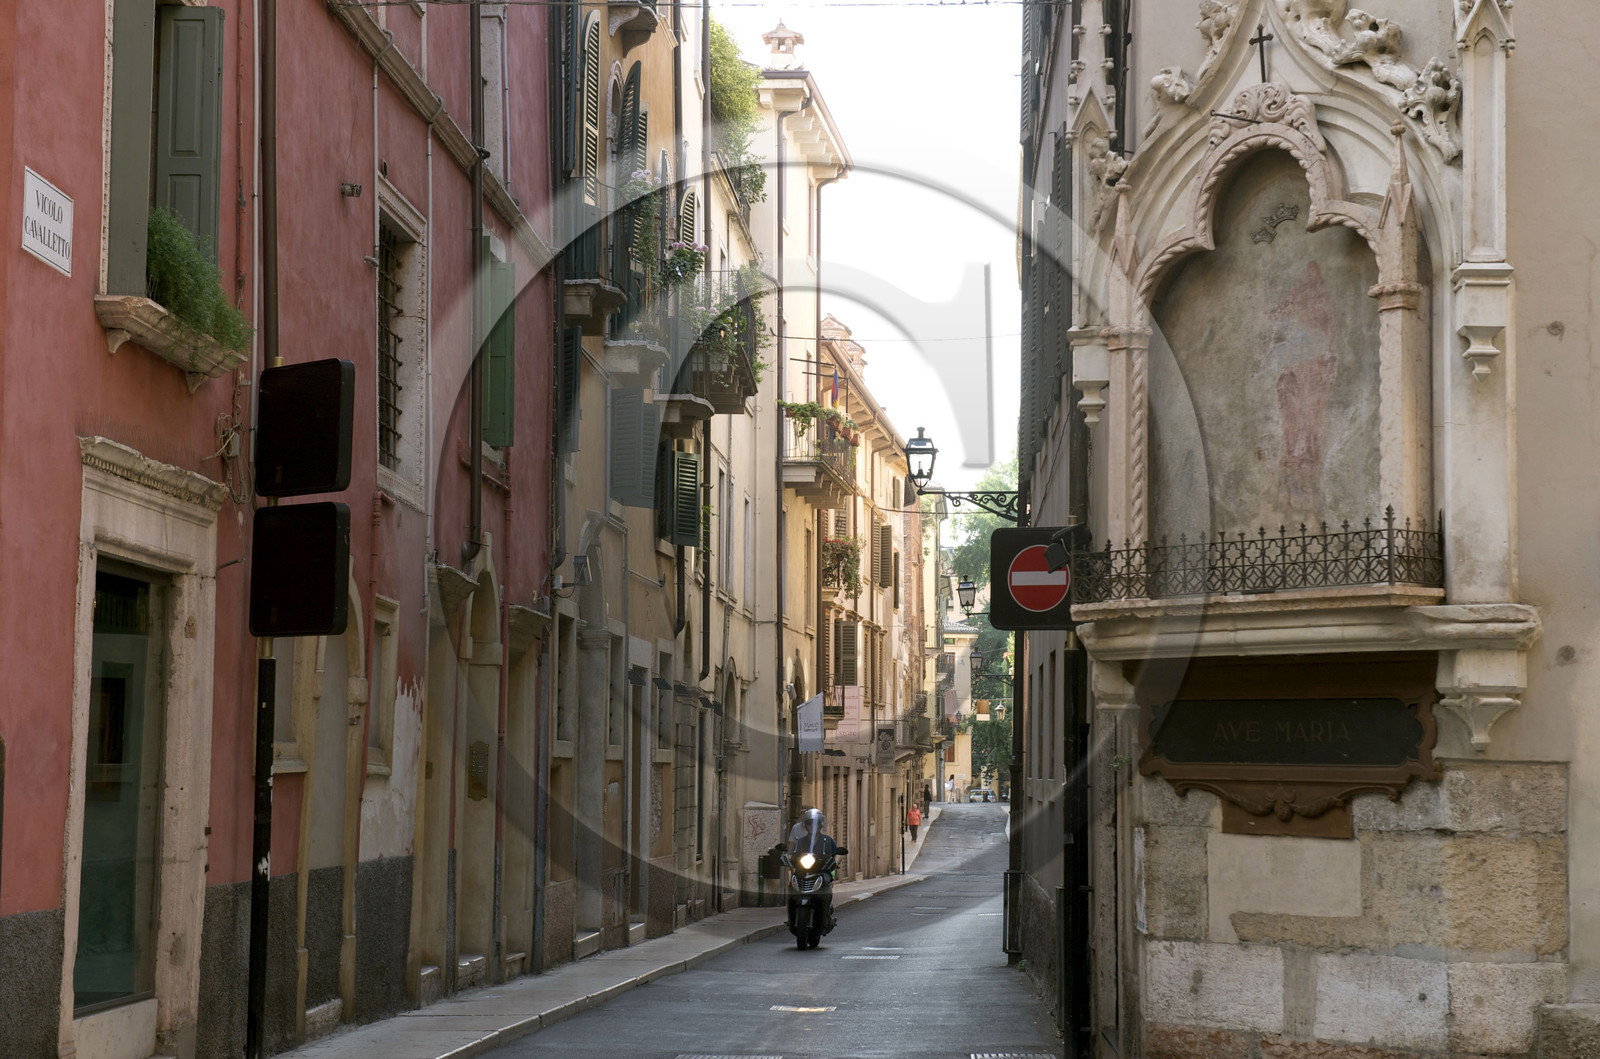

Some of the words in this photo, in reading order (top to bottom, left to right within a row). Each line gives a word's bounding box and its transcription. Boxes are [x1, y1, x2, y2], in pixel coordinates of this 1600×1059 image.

[36, 190, 63, 224] VICOLO
[24, 215, 71, 260] CAVALLETTO
[1214, 721, 1260, 743] AVE
[1276, 721, 1352, 743] MARIA
